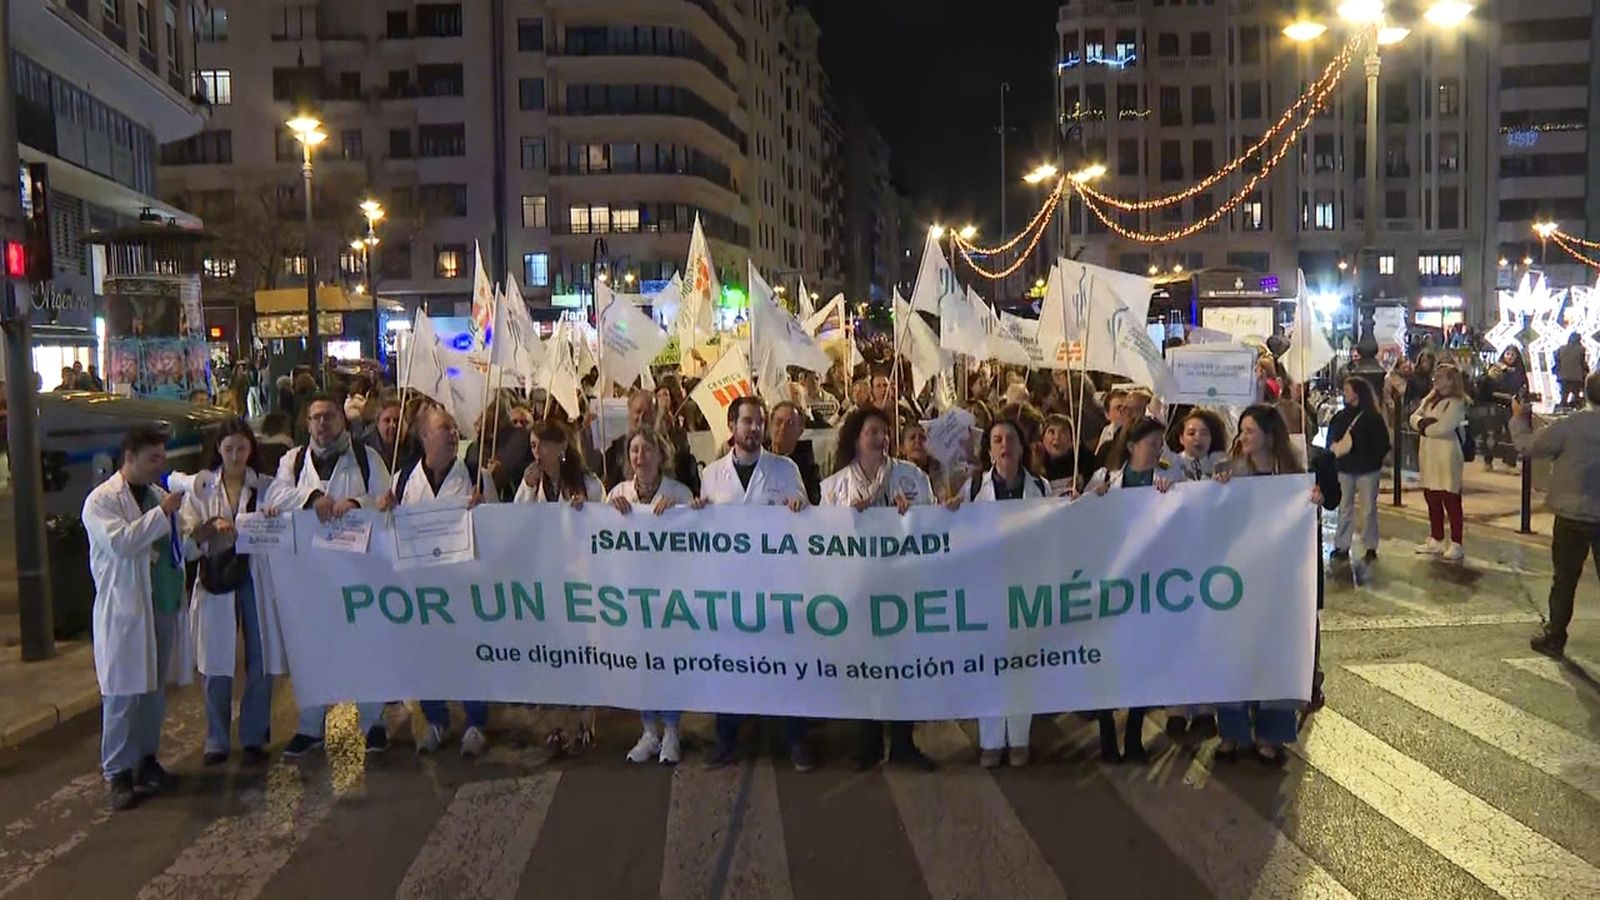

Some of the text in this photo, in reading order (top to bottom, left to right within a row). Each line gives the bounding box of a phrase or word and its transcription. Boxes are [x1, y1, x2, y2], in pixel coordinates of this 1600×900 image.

[590, 530, 951, 559] ¡SALVEMOS LA SANIDAD!
[341, 566, 1244, 639] POR UN ESTATUTO DEL MÉDICO
[475, 643, 1102, 681] Que dignifique la profesión y la atención al paciente
